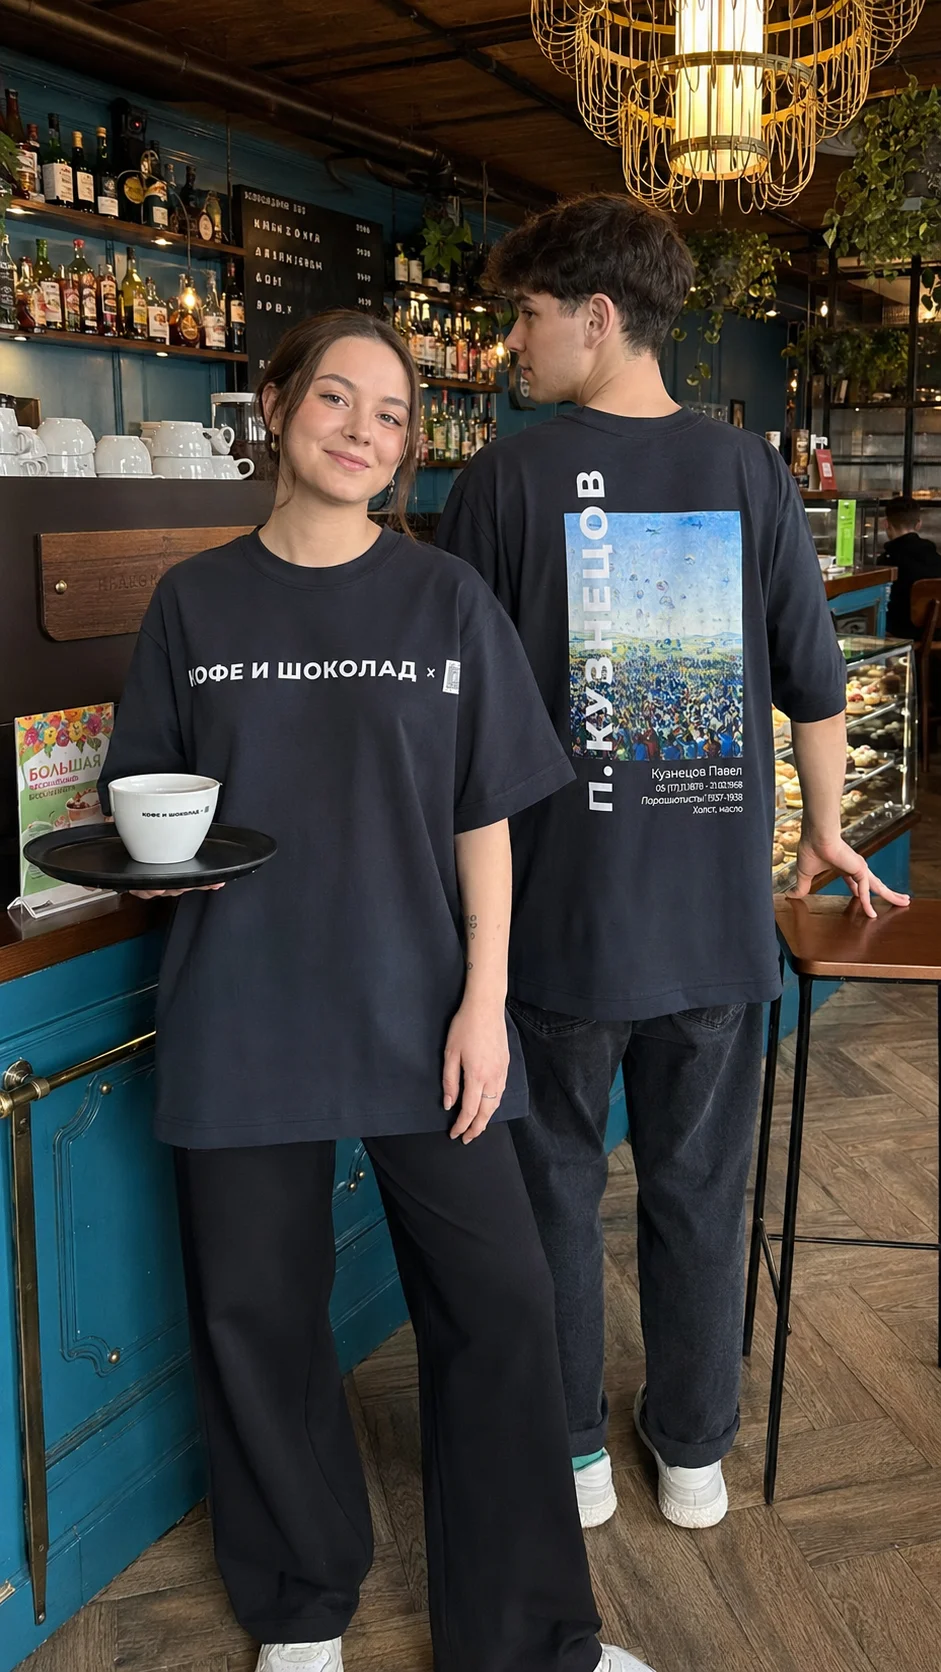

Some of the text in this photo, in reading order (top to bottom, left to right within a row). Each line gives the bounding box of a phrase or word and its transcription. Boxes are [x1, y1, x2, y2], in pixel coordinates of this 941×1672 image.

[576, 470, 613, 751] КУЗНЕЦОВ
[188, 662, 244, 687] КОФЕ
[251, 662, 269, 679] И
[277, 660, 417, 683] ШОКОЛАД
[651, 765, 743, 781] Кузнецов Павел
